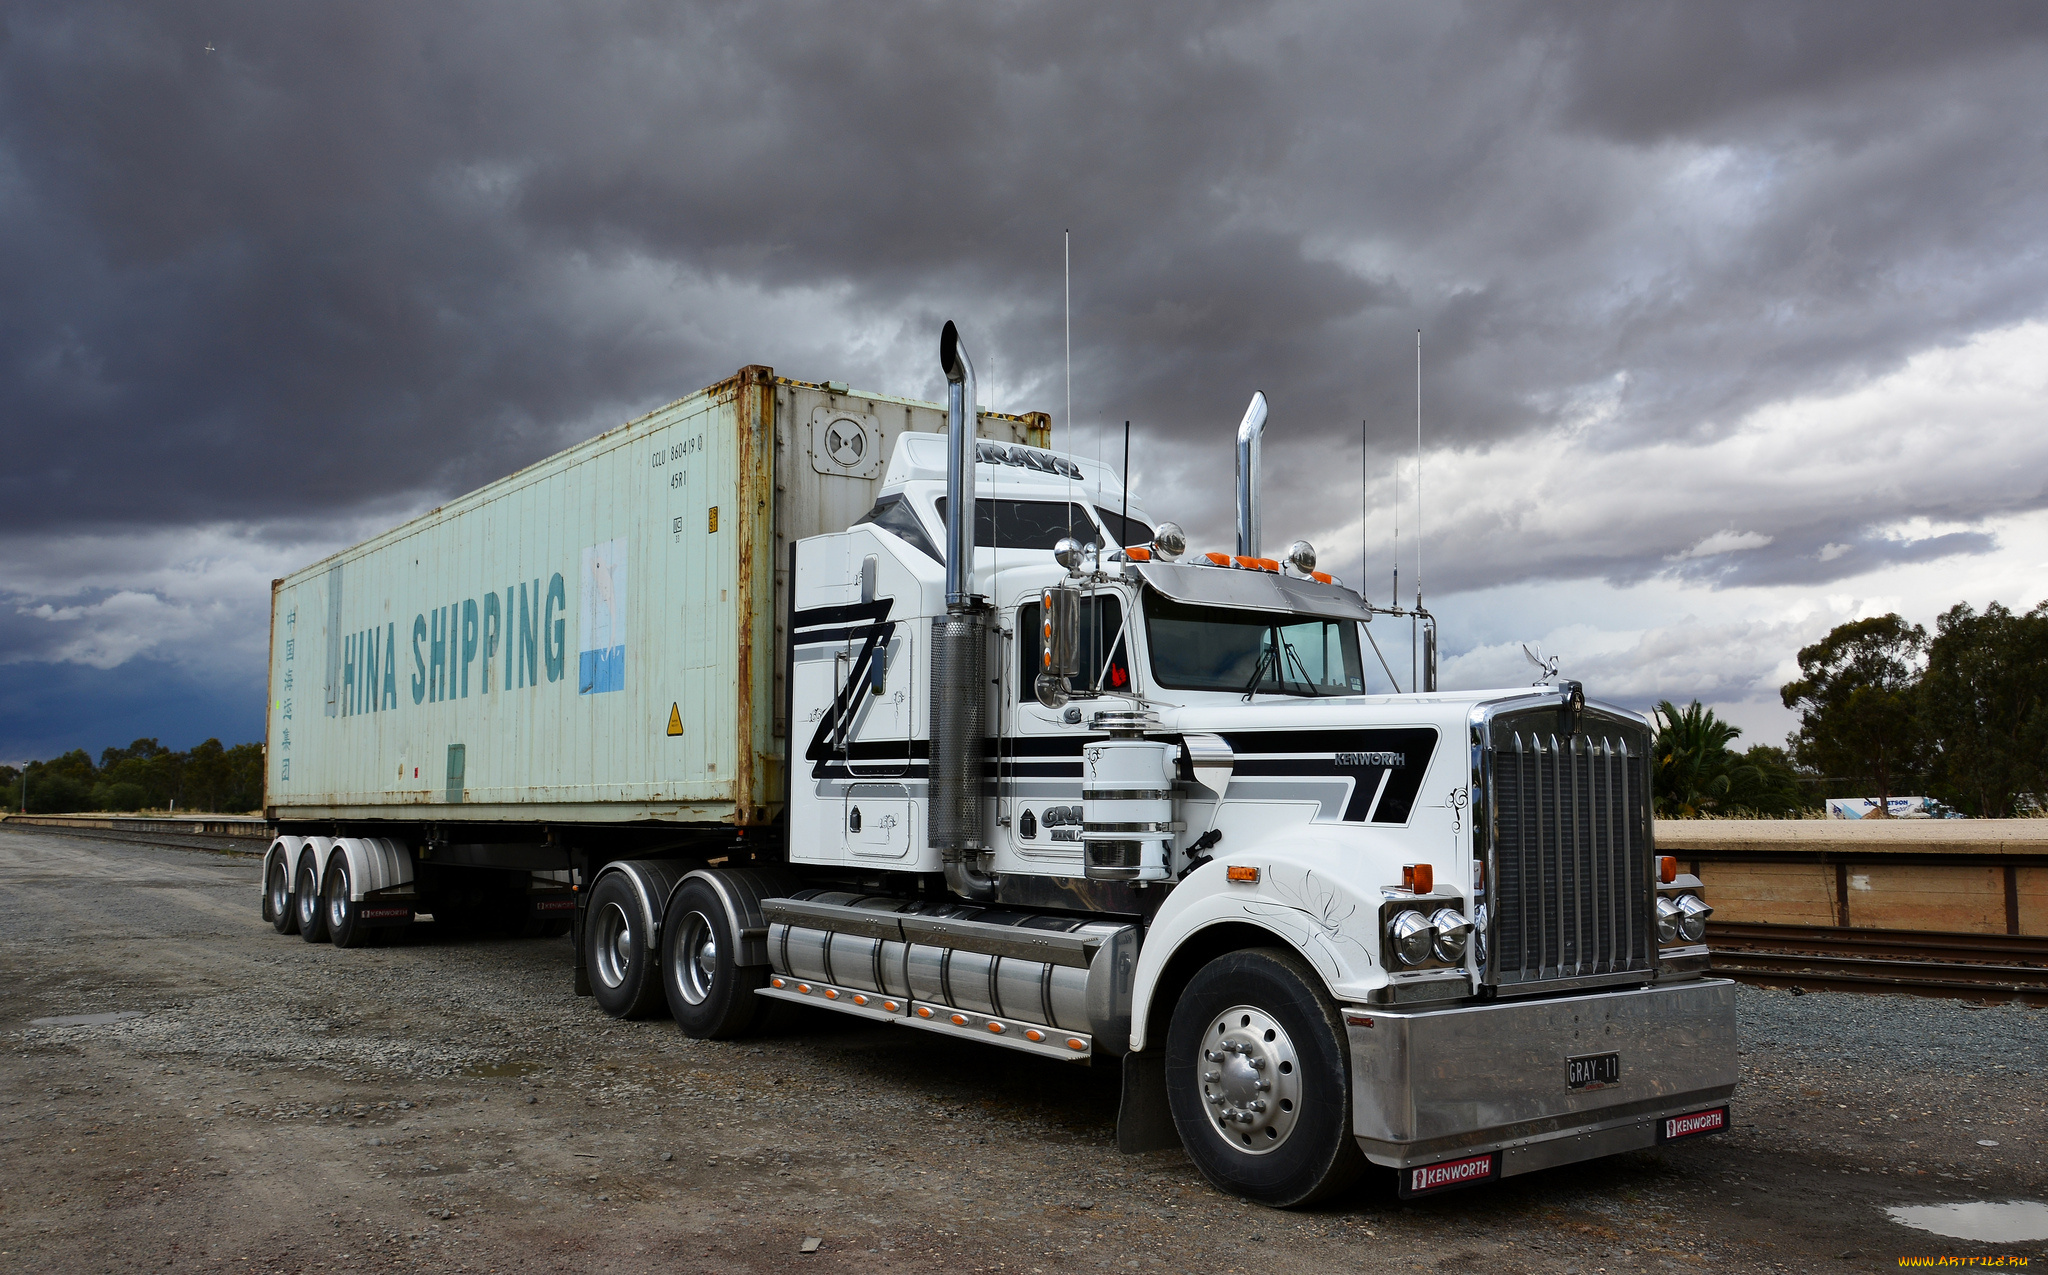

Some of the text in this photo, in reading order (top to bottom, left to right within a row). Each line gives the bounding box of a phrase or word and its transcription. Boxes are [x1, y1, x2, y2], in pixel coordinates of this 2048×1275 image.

[652, 449, 666, 468] CCLU
[670, 437, 695, 461] 860419
[976, 442, 1084, 480] RAYS
[670, 470, 686, 489] 45R1
[330, 571, 566, 718] HINA SHIPPING
[1334, 752, 1405, 766] KENWORTH
[1041, 805, 1083, 828] GRA
[1676, 1113, 1722, 1133] KENWORTH
[1427, 1160, 1490, 1184] KENWORTH
